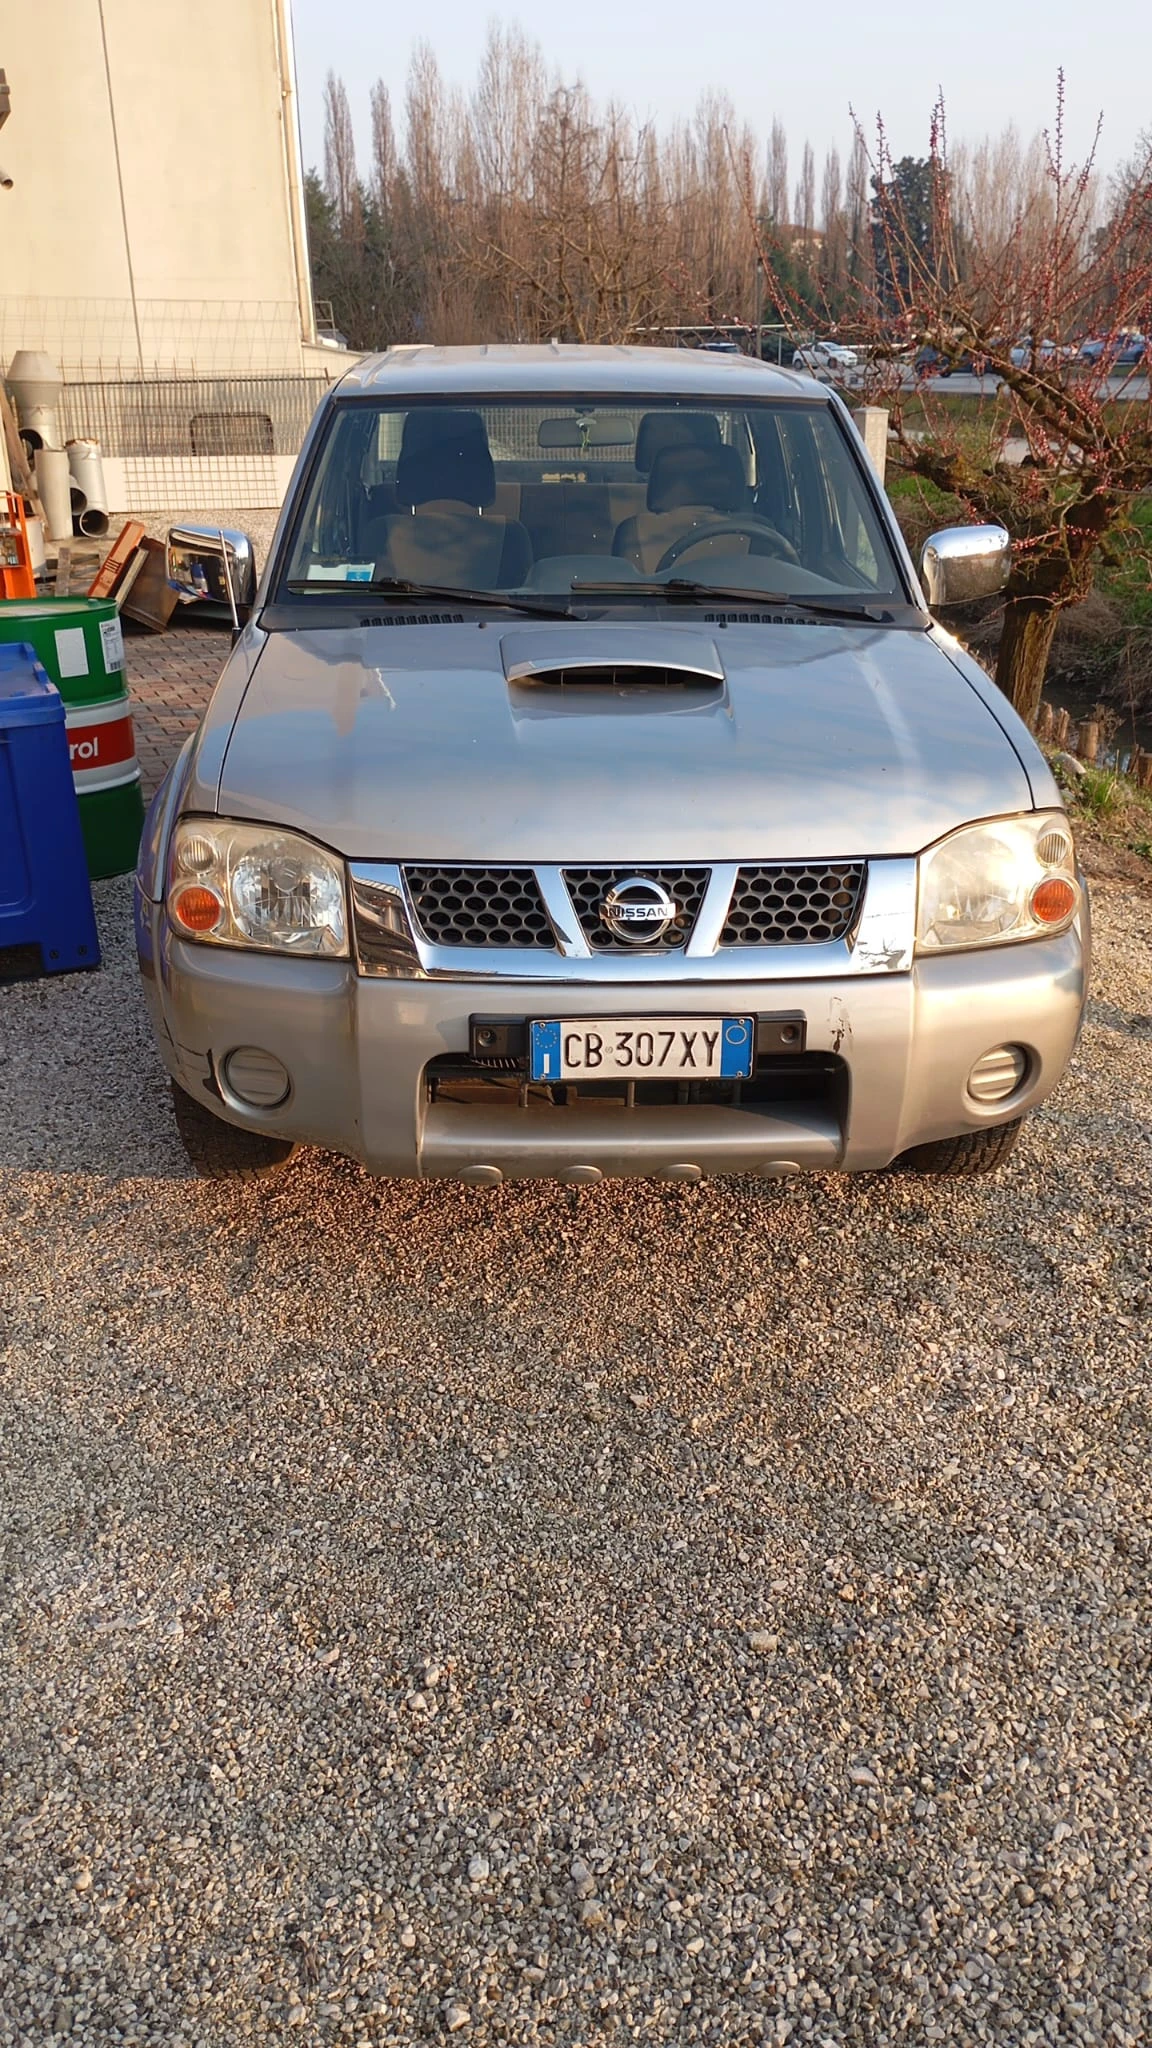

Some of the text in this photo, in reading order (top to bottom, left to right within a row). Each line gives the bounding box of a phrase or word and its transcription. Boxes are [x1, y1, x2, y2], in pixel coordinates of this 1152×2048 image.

[608, 907, 668, 918] NISSAN
[564, 1033, 603, 1067] CB
[615, 1031, 719, 1067] 307XY
